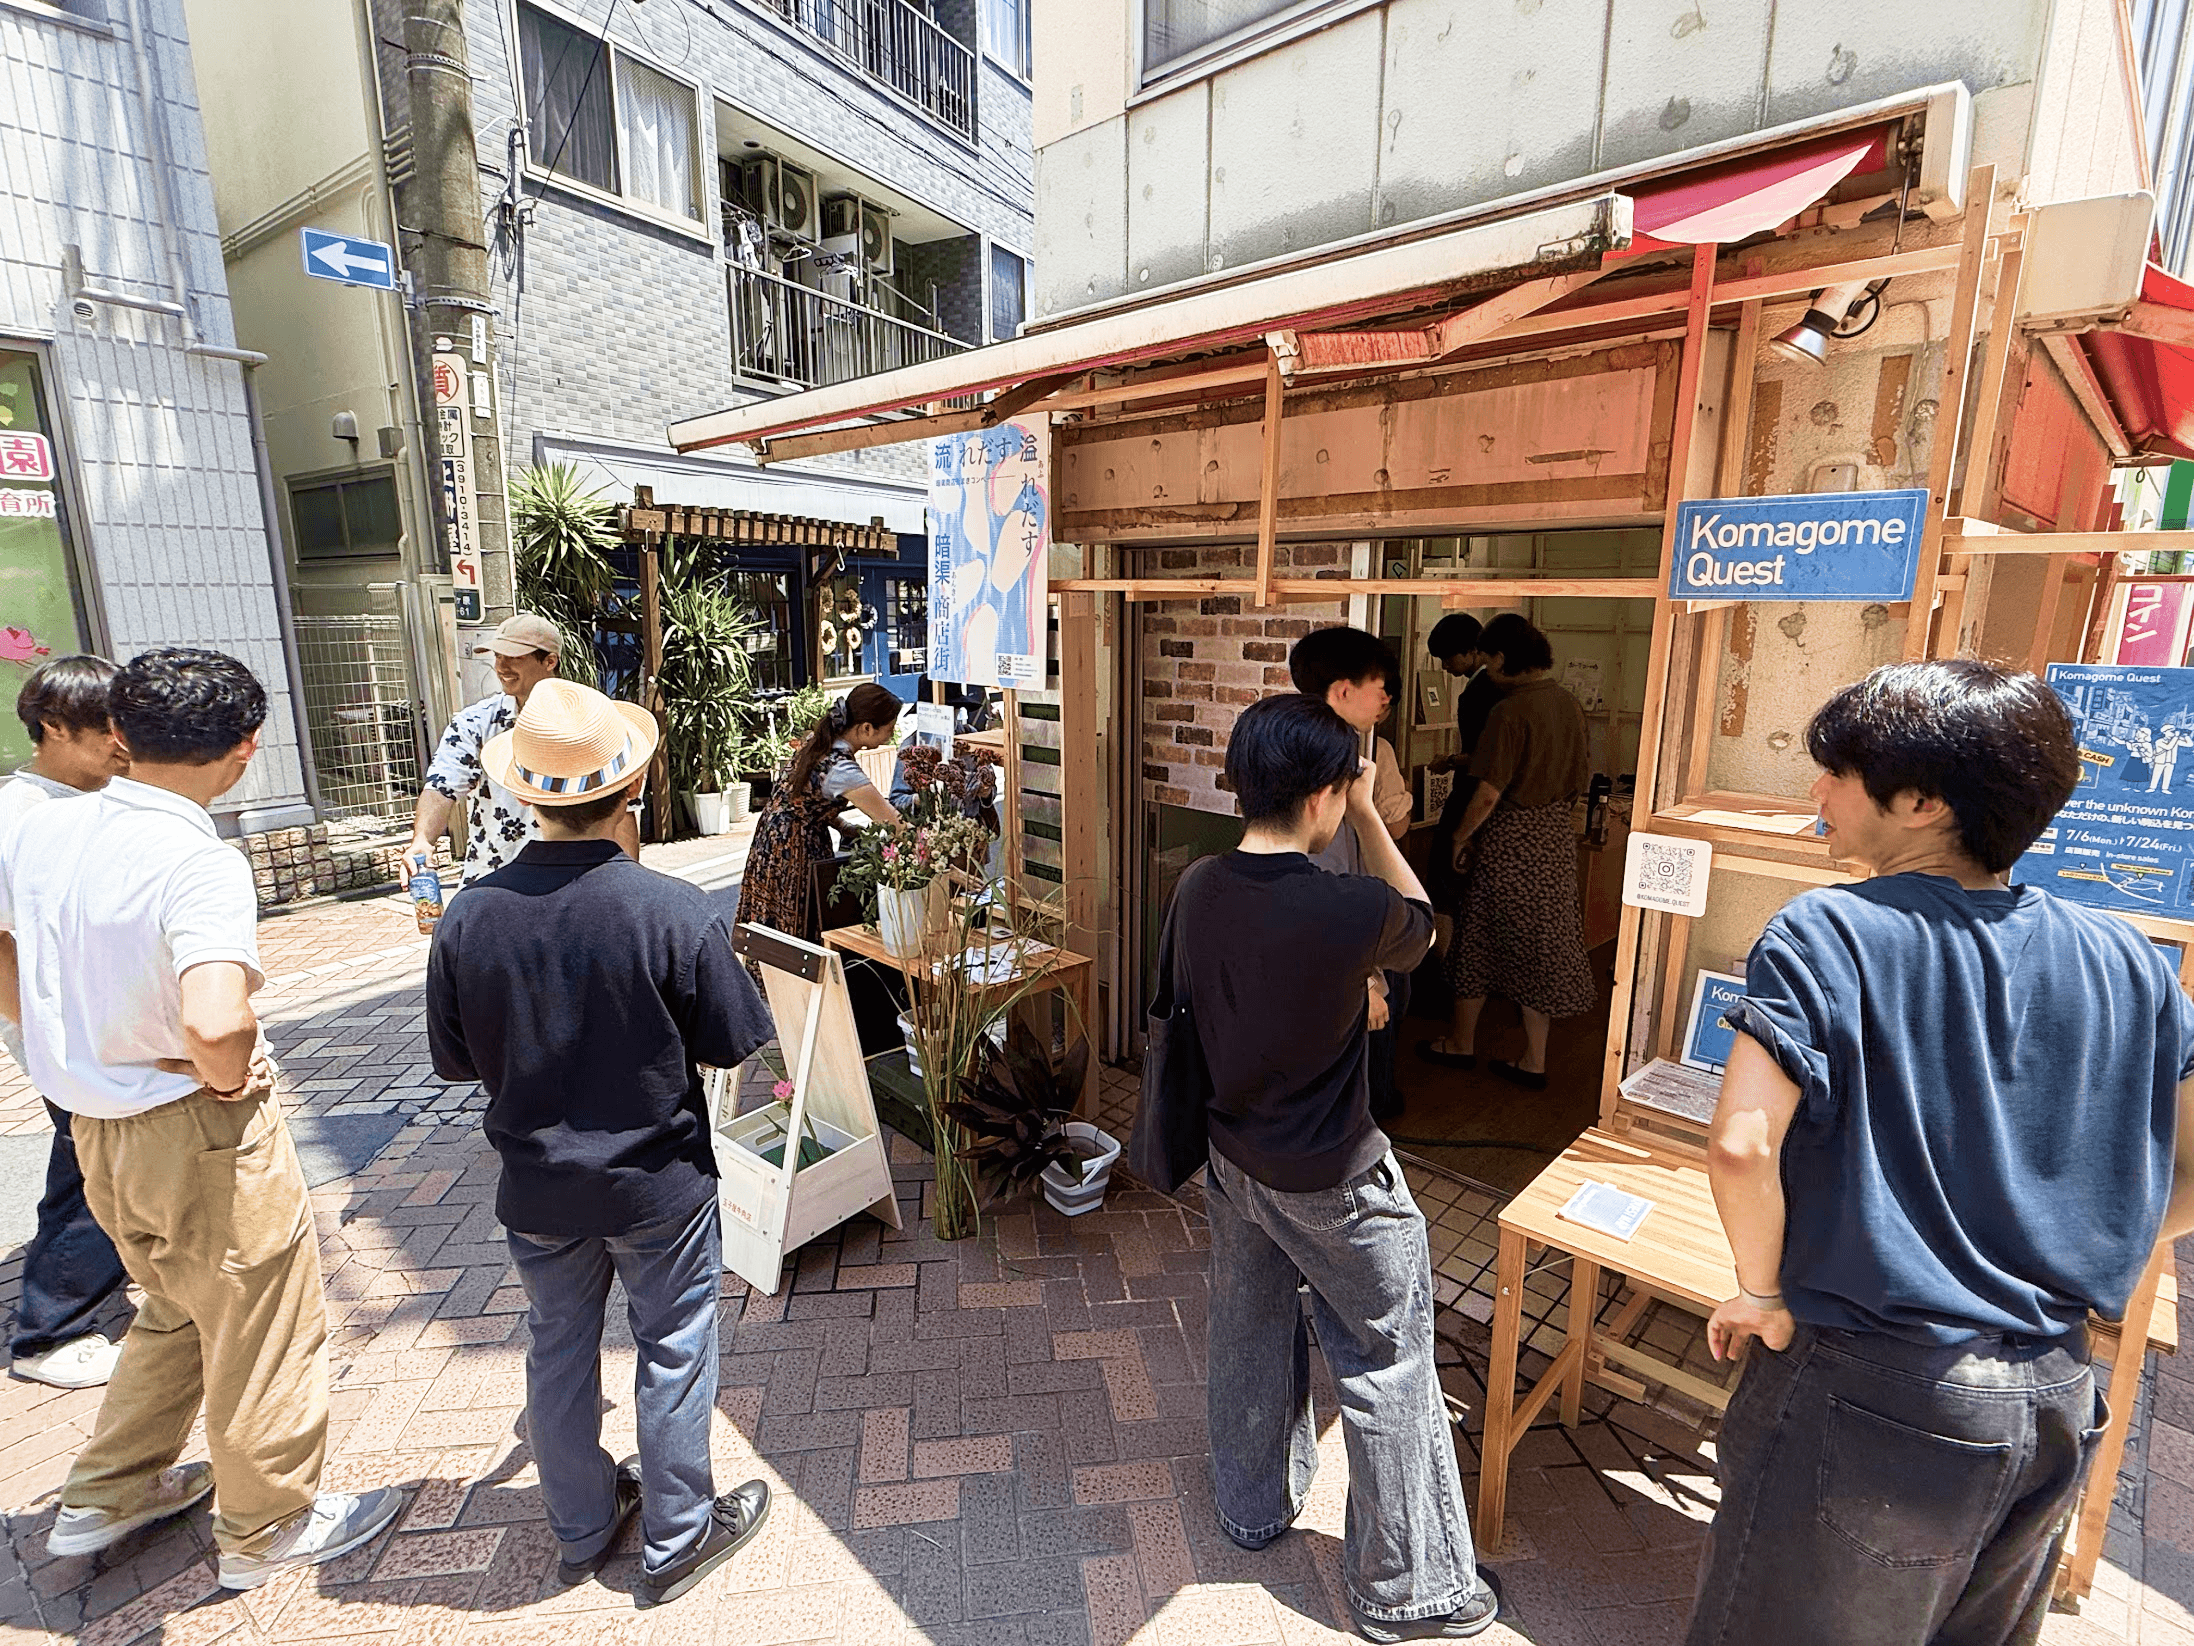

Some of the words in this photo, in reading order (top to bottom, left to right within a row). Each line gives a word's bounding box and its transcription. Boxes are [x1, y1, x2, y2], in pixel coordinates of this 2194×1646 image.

[934, 437, 1012, 469] 流れだす
[1019, 434, 1039, 558] 溢れだす
[1690, 514, 1906, 555] Komagome
[1686, 552, 1786, 587] Quest
[935, 533, 950, 672] 暗渠商店街
[2125, 585, 2163, 643] コイン
[2059, 671, 2124, 683] Komagome
[2126, 672, 2161, 683] Quest
[2084, 752, 2110, 764] CASH
[2085, 799, 2106, 811] the
[2107, 803, 2168, 817] unknown
